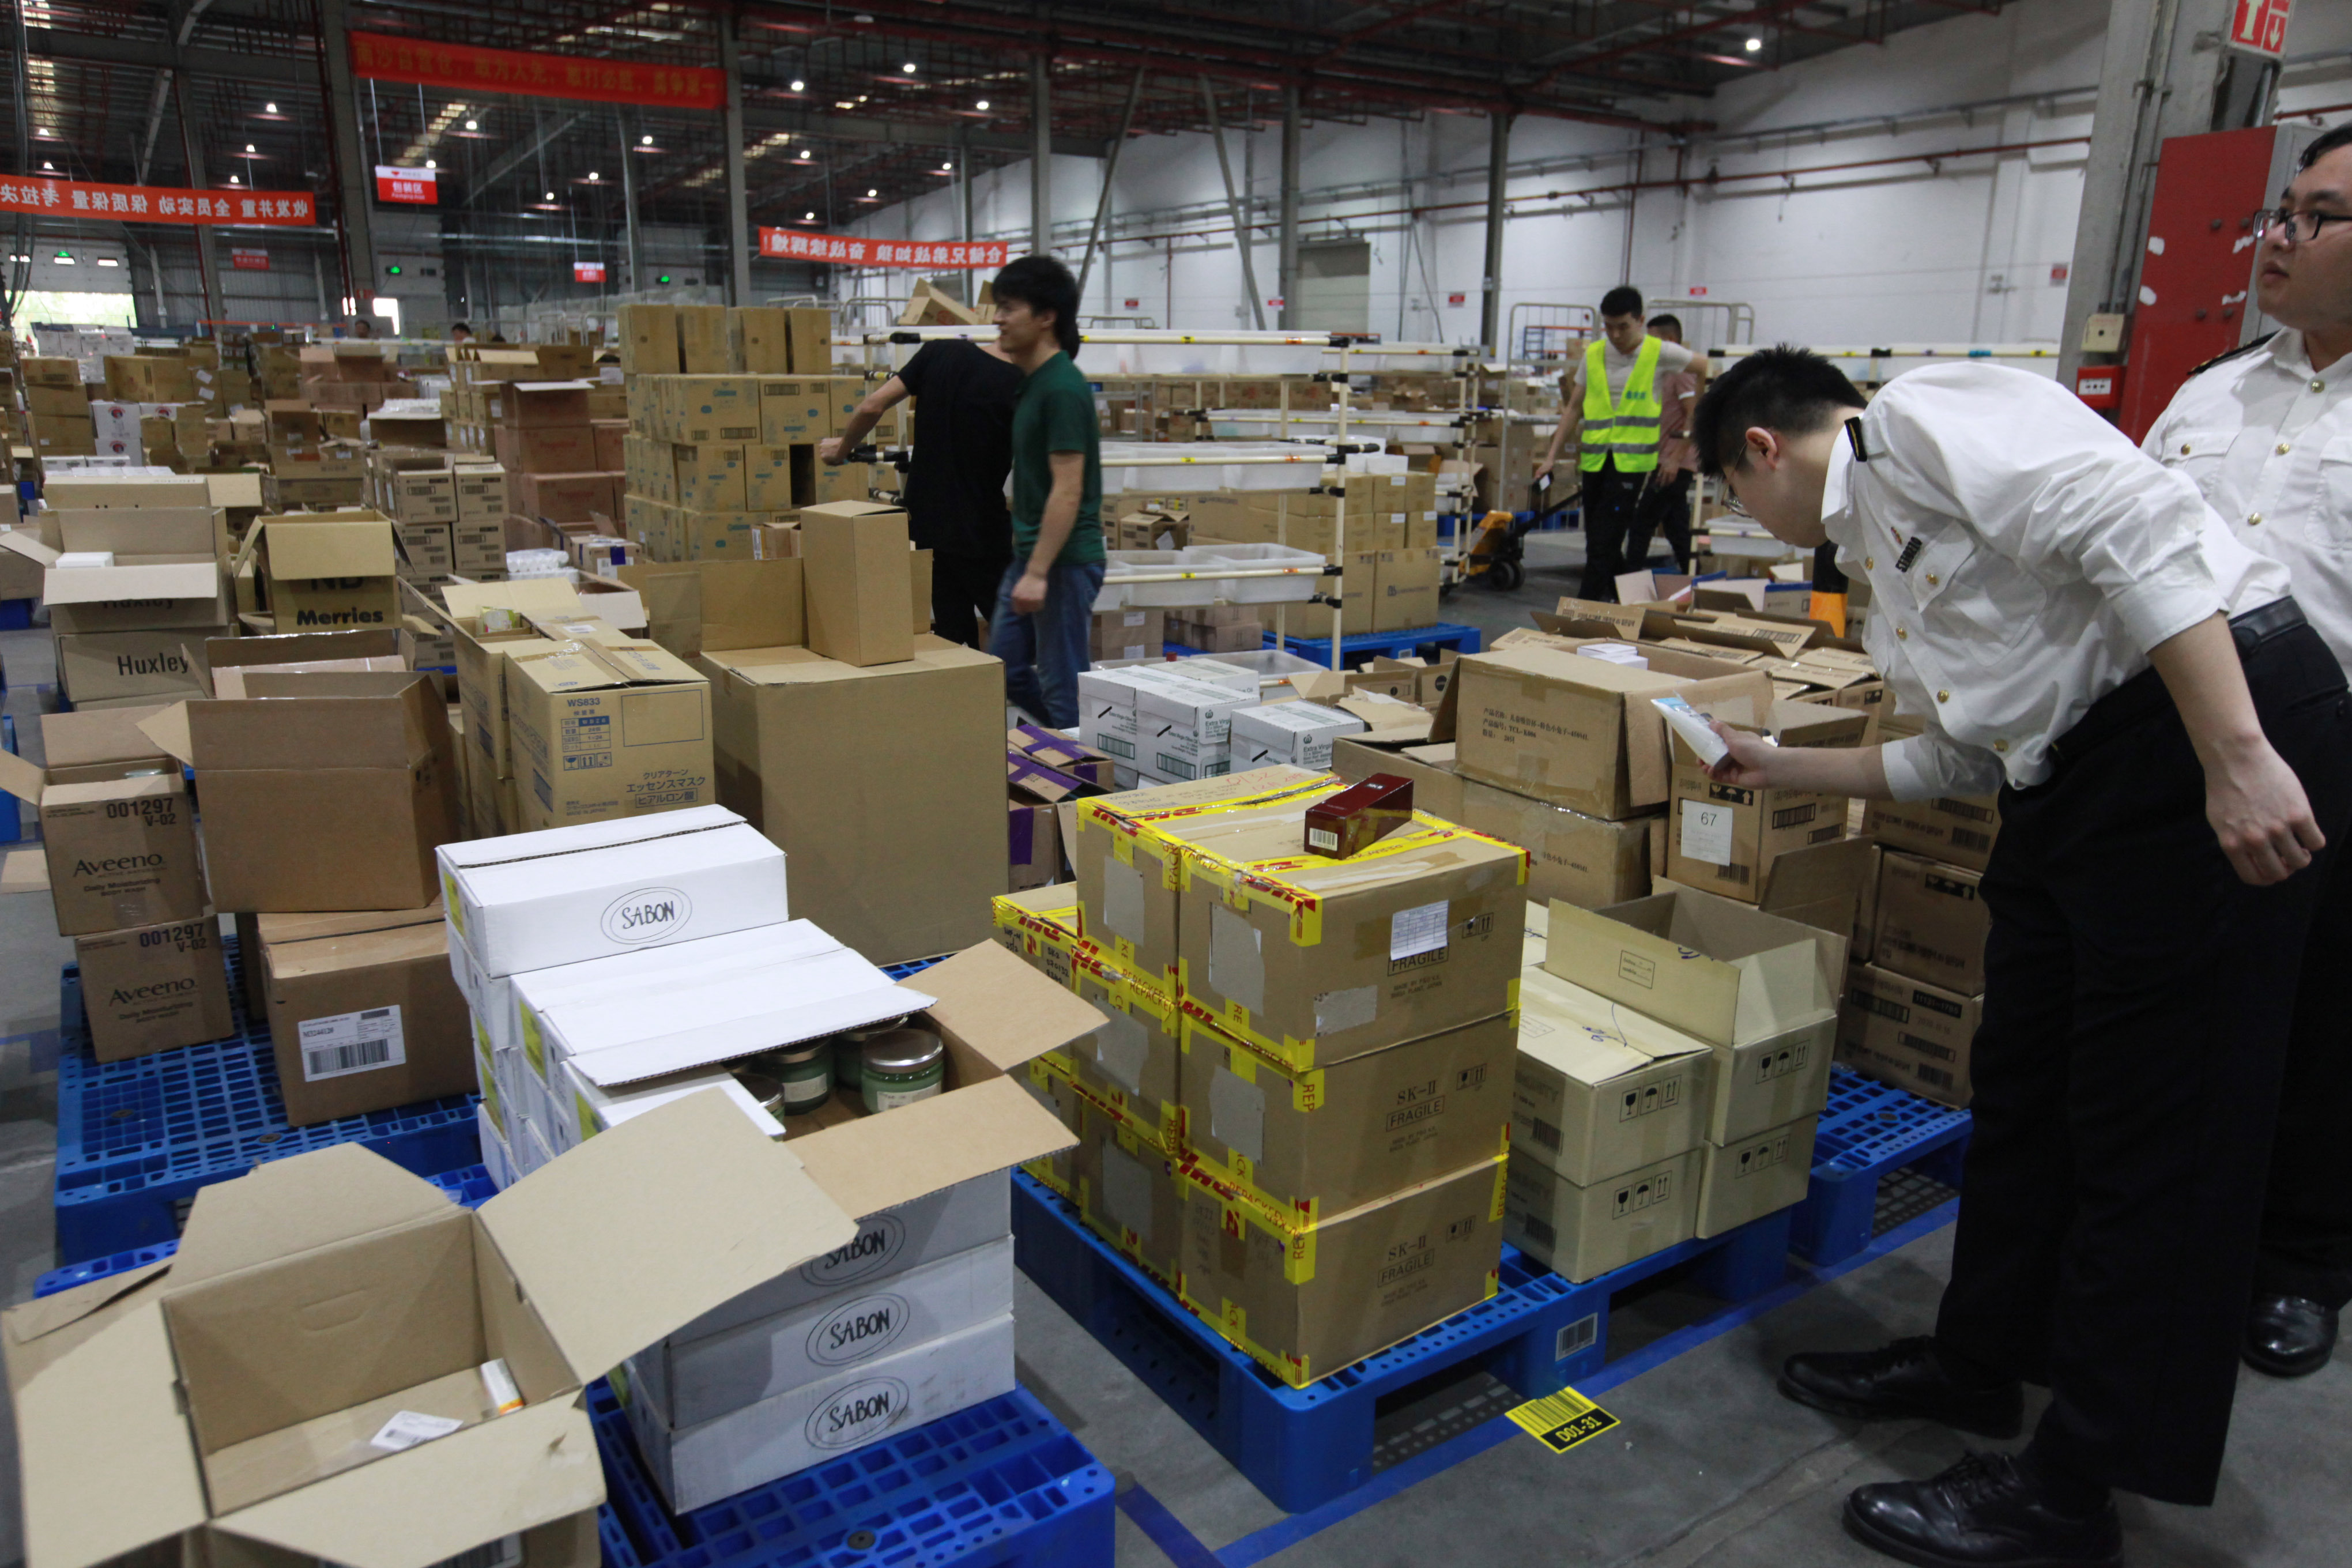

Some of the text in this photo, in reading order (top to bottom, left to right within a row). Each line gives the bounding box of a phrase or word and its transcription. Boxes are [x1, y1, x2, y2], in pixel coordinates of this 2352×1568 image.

[296, 606, 384, 626] Merries
[117, 652, 189, 676] Huxley
[567, 698, 601, 707] WS833
[627, 777, 706, 793] エッセンスマスク
[643, 769, 689, 779] クリアターン
[106, 798, 174, 819] 001297
[145, 813, 176, 827] V-02
[1701, 812, 1717, 827] 67
[73, 854, 163, 877] Aveeno
[621, 900, 675, 930] SABON
[139, 923, 205, 948] 001297
[176, 937, 208, 953] V-02
[1392, 947, 1446, 972] FRAGILE
[109, 978, 195, 1007] Aveeno
[1397, 1080, 1437, 1105] SK-II
[1390, 1100, 1441, 1127] FRAGILE
[1388, 1235, 1426, 1261] SK-II
[1382, 1253, 1430, 1282] FRAGILE
[830, 1307, 891, 1351] SABON
[828, 1390, 890, 1434] SABON
[1555, 1415, 1603, 1442] D01-31
